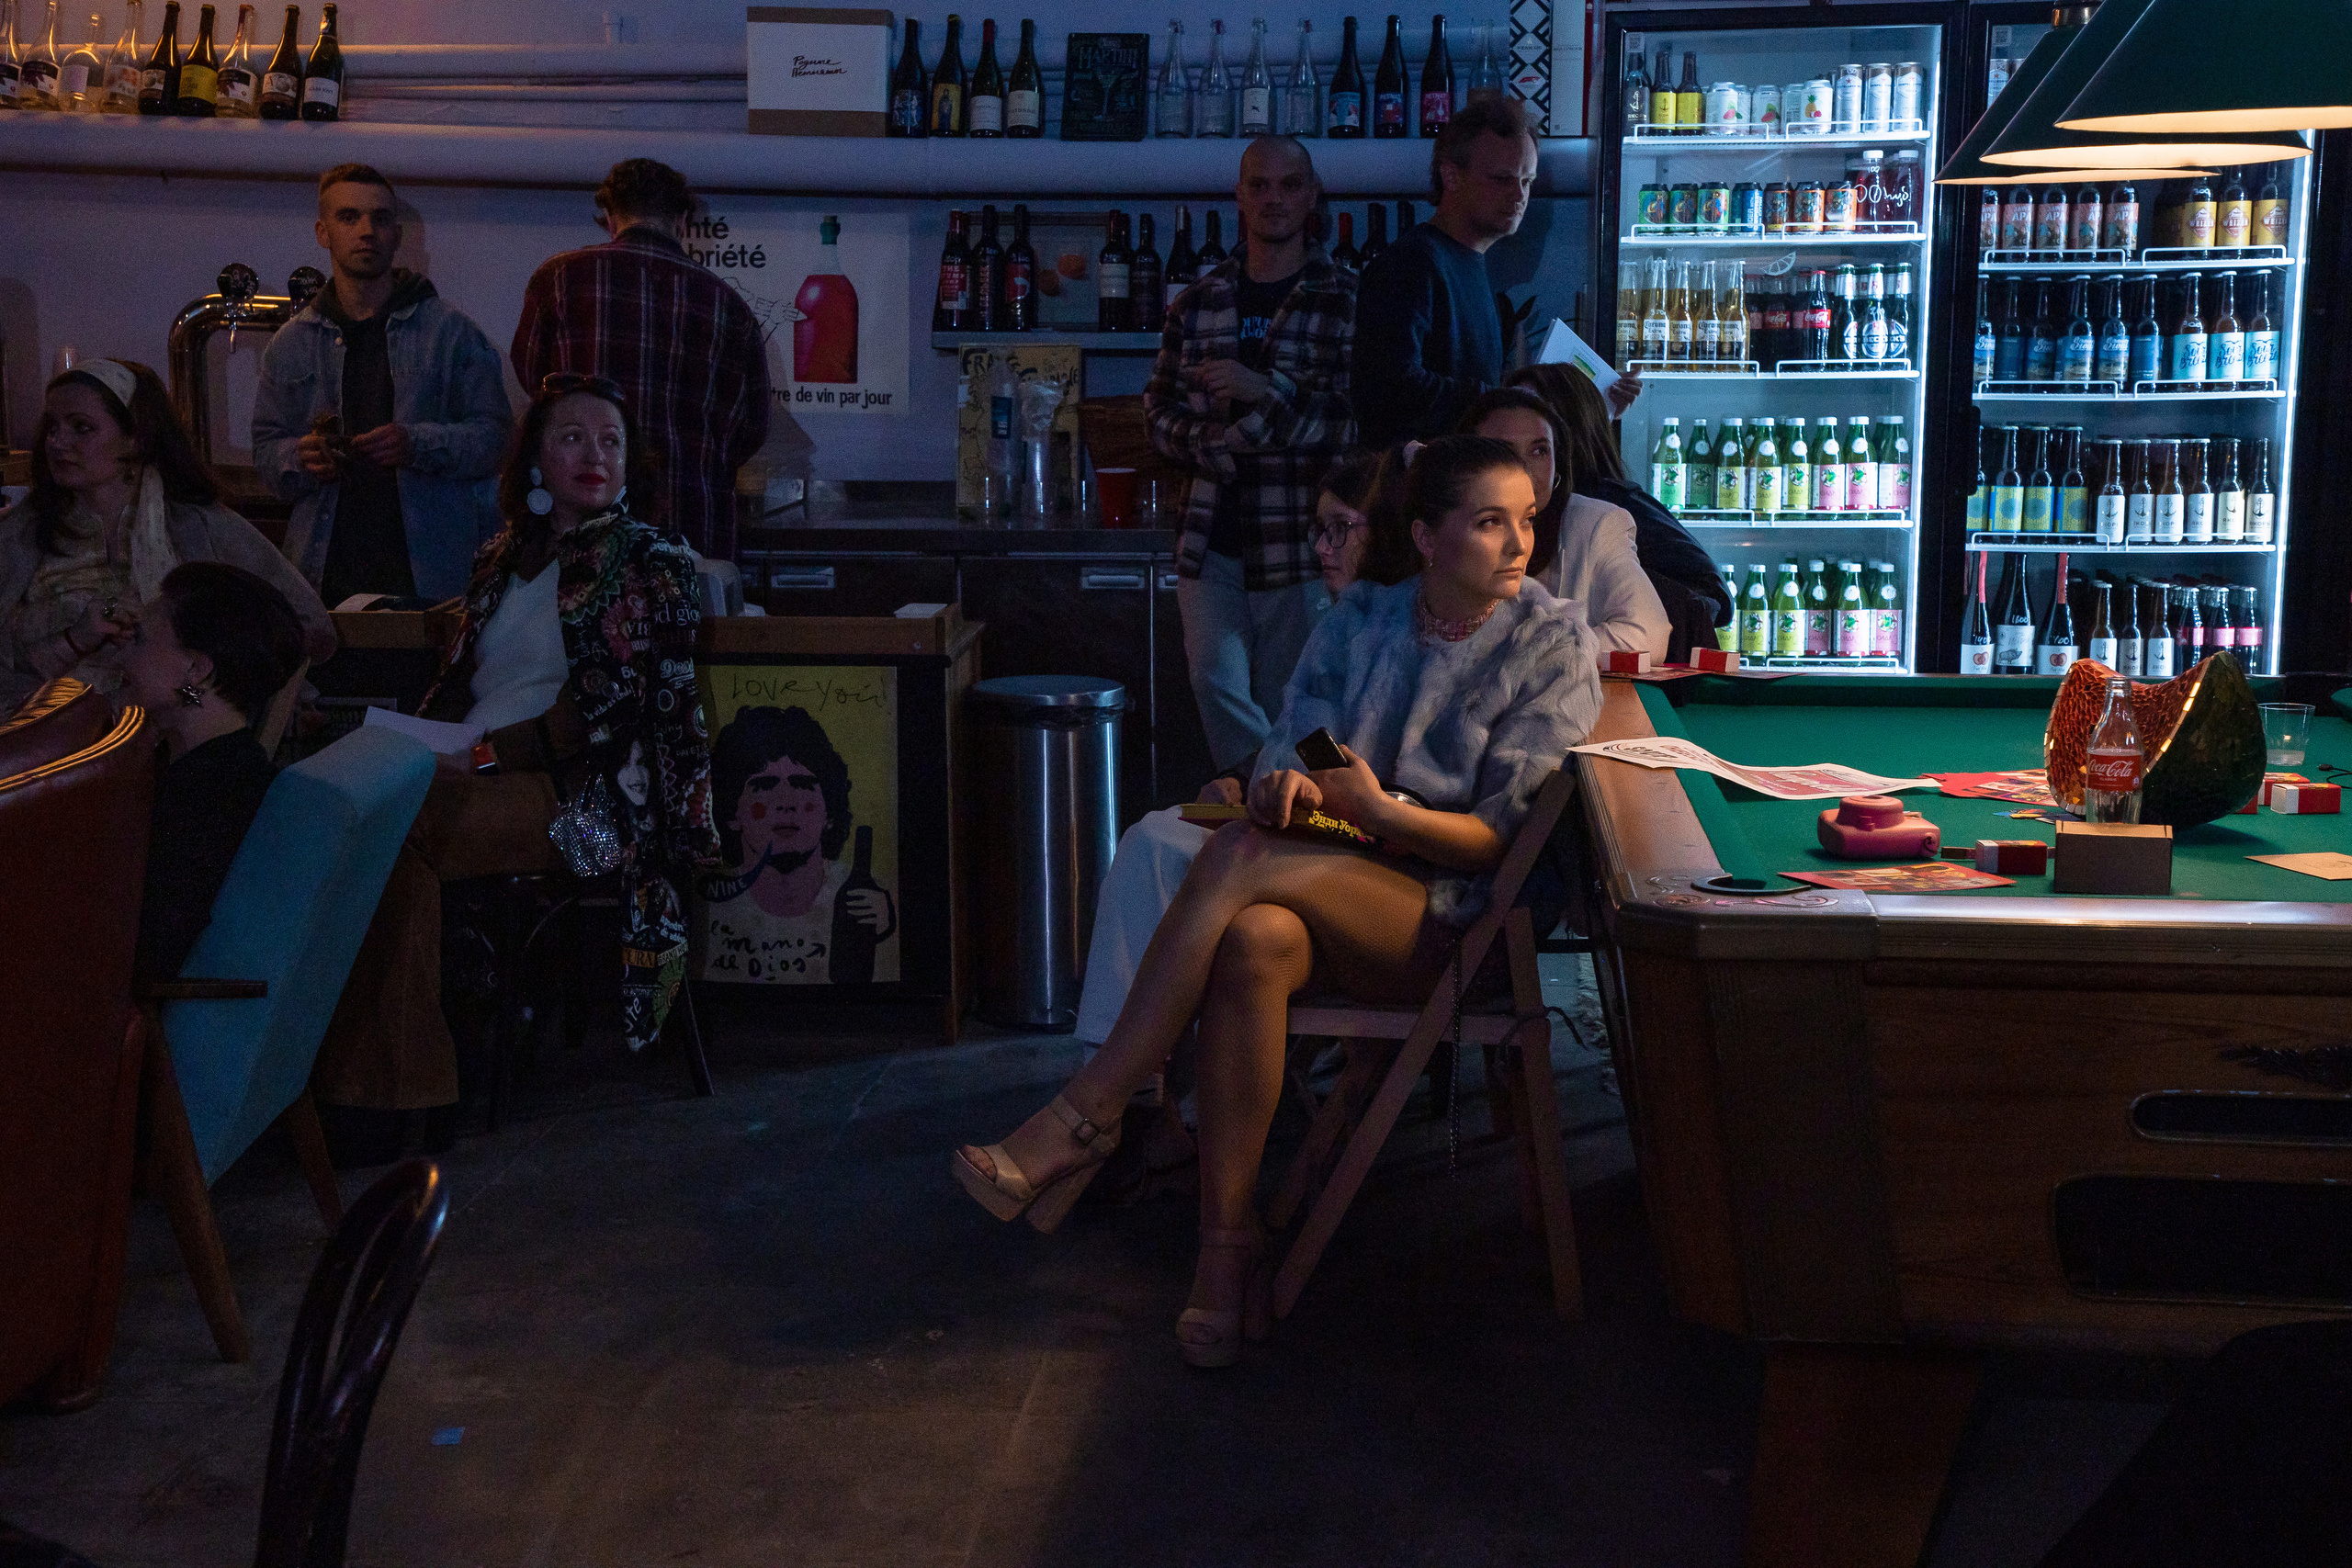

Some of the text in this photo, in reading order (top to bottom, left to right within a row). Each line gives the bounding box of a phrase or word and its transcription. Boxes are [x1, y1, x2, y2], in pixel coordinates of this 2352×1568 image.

[2012, 212, 2032, 221] APA
[2045, 211, 2066, 221] APA
[2114, 211, 2135, 221] APA
[688, 243, 767, 268] briété
[771, 385, 893, 410] tre de vin par jour
[711, 919, 734, 935] la
[722, 937, 805, 954] mano
